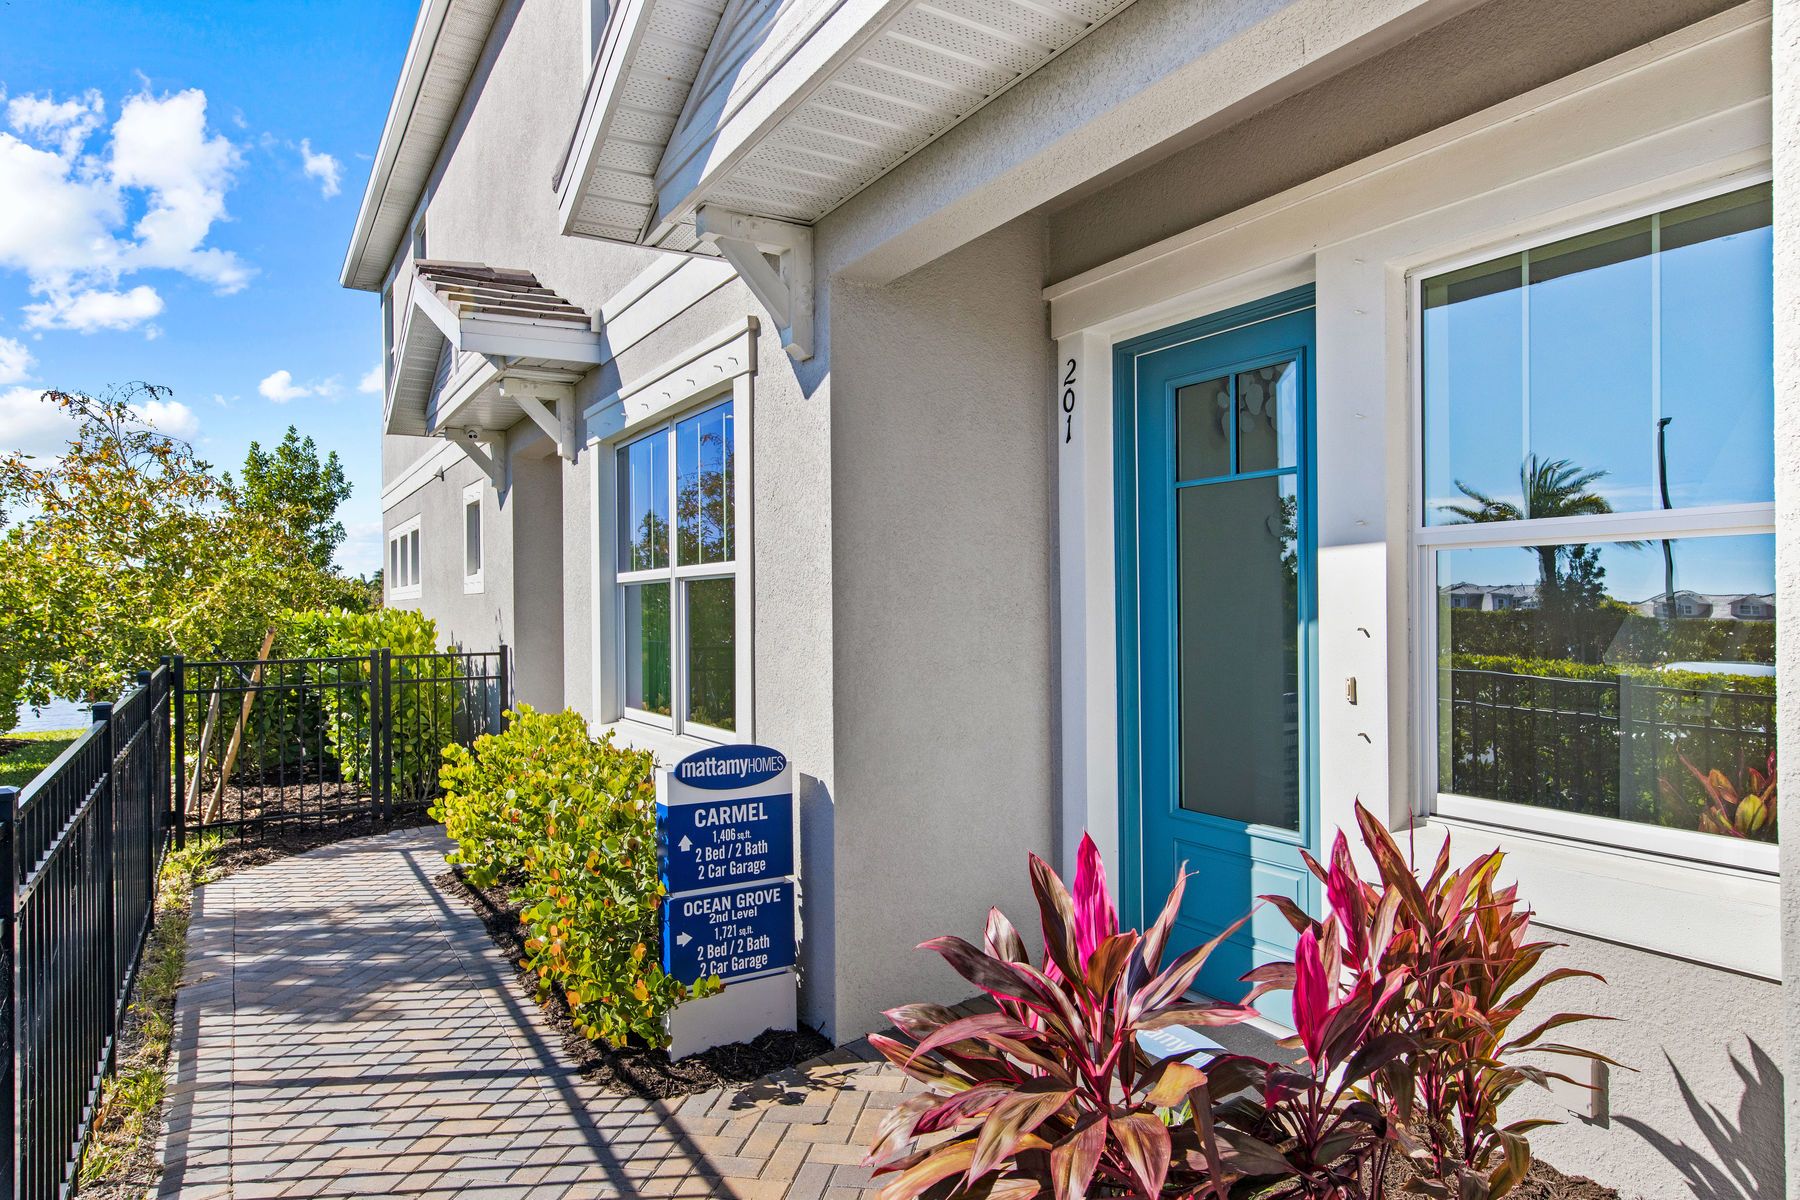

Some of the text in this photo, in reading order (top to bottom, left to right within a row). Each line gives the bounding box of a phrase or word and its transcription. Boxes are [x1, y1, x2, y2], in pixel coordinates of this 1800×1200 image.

[1063, 358, 1076, 444] 201
[694, 802, 768, 828] CARMEL
[712, 828, 736, 844] 1,406
[695, 839, 768, 863] 2 Bed / 2 Bath
[698, 859, 766, 880] 2 Car Garage
[683, 888, 781, 917] OCEAN GROVE
[709, 906, 758, 924] 2nd Level
[714, 924, 737, 941] 1,721
[697, 934, 770, 961] 2 Bed / 2 Bath
[700, 954, 768, 978] 2 Car Garage
